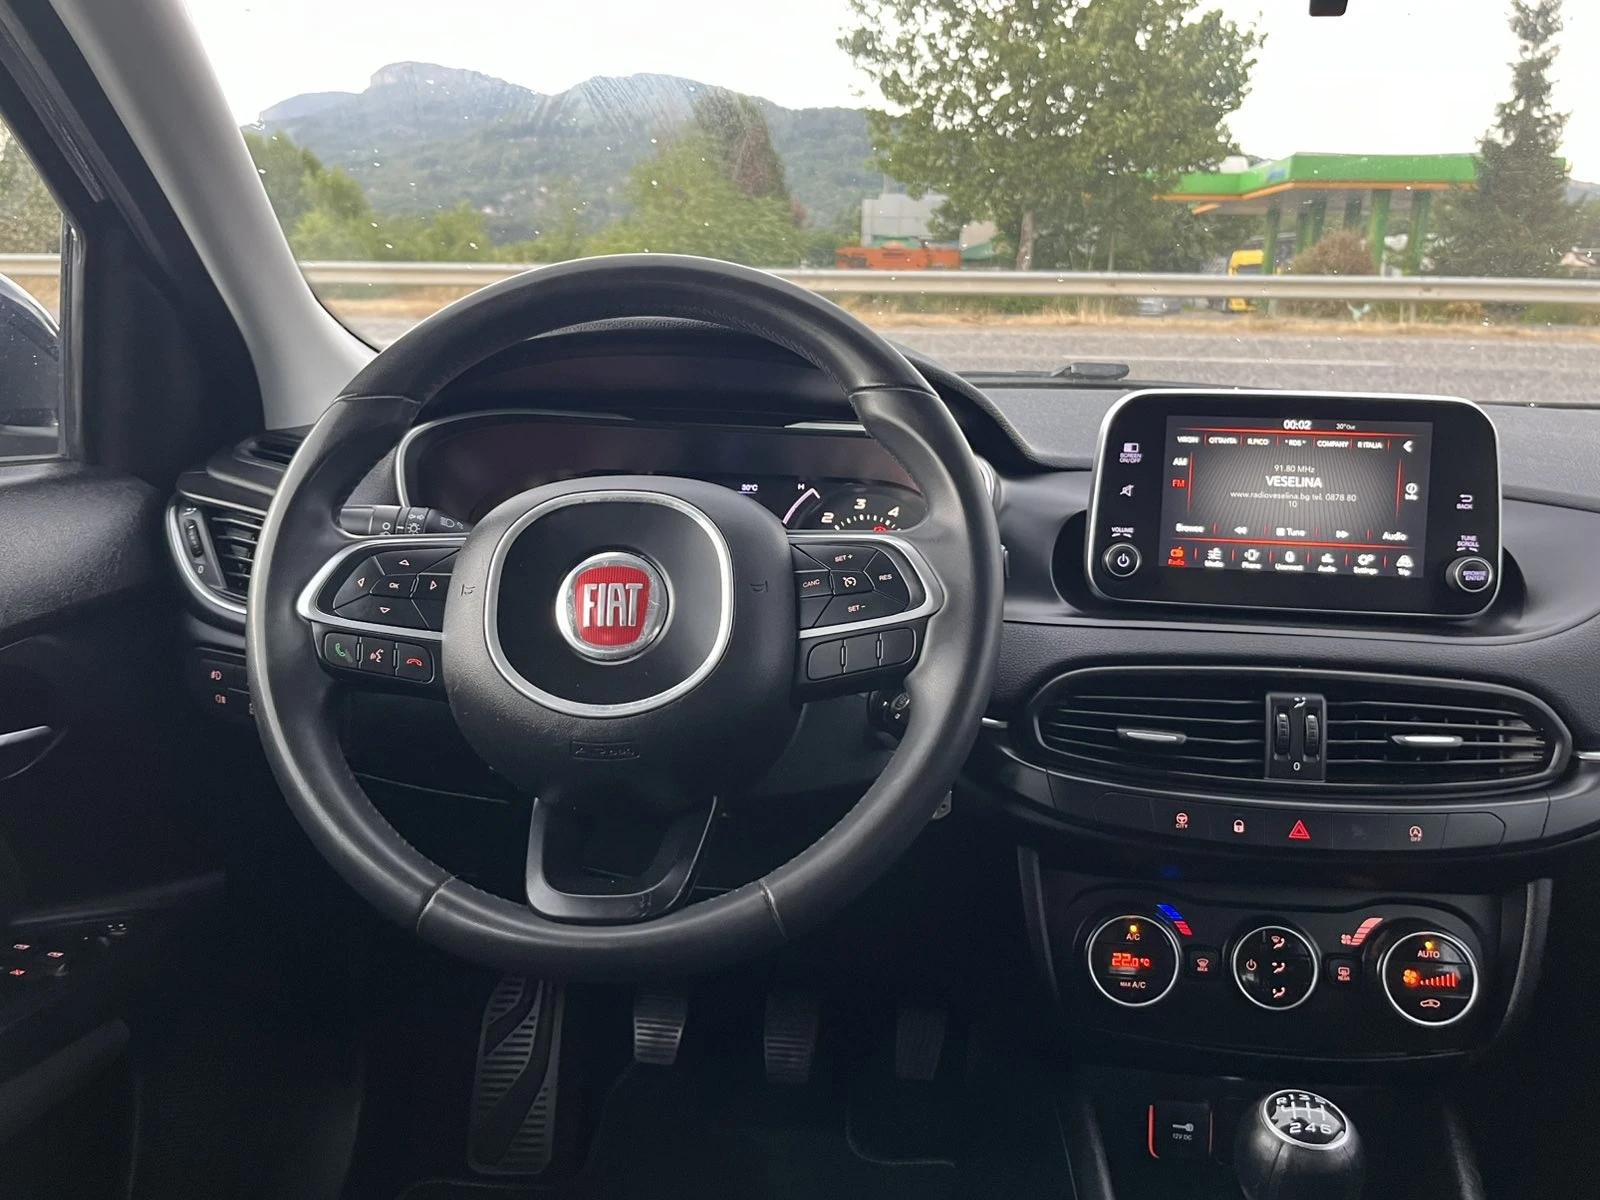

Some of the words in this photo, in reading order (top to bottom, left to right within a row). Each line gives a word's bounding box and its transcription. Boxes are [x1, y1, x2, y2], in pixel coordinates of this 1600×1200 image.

[1283, 419, 1312, 430] 00:02
[1317, 440, 1349, 448] COMPANY
[1172, 457, 1188, 466] AM
[1172, 479, 1185, 487] FM
[1265, 475, 1323, 488] VESELINA
[1230, 491, 1310, 501] www.radioveselina.bg
[854, 498, 867, 510] 3
[888, 506, 900, 518] 4
[821, 512, 834, 524] 2
[1175, 523, 1205, 533] Browse
[1287, 528, 1306, 536] Tune
[1382, 532, 1408, 541] Audio
[878, 573, 893, 581] RES
[802, 579, 821, 588] CANC
[583, 582, 644, 628] FIAT
[847, 605, 860, 613] SET
[1126, 933, 1141, 941] A/C
[1417, 950, 1440, 959] AUTO
[1111, 952, 1139, 968] 22.0
[1276, 1096, 1288, 1105] R
[1289, 1121, 1302, 1134] 2
[1304, 1121, 1316, 1133] 4
[1320, 1123, 1332, 1135] 6
